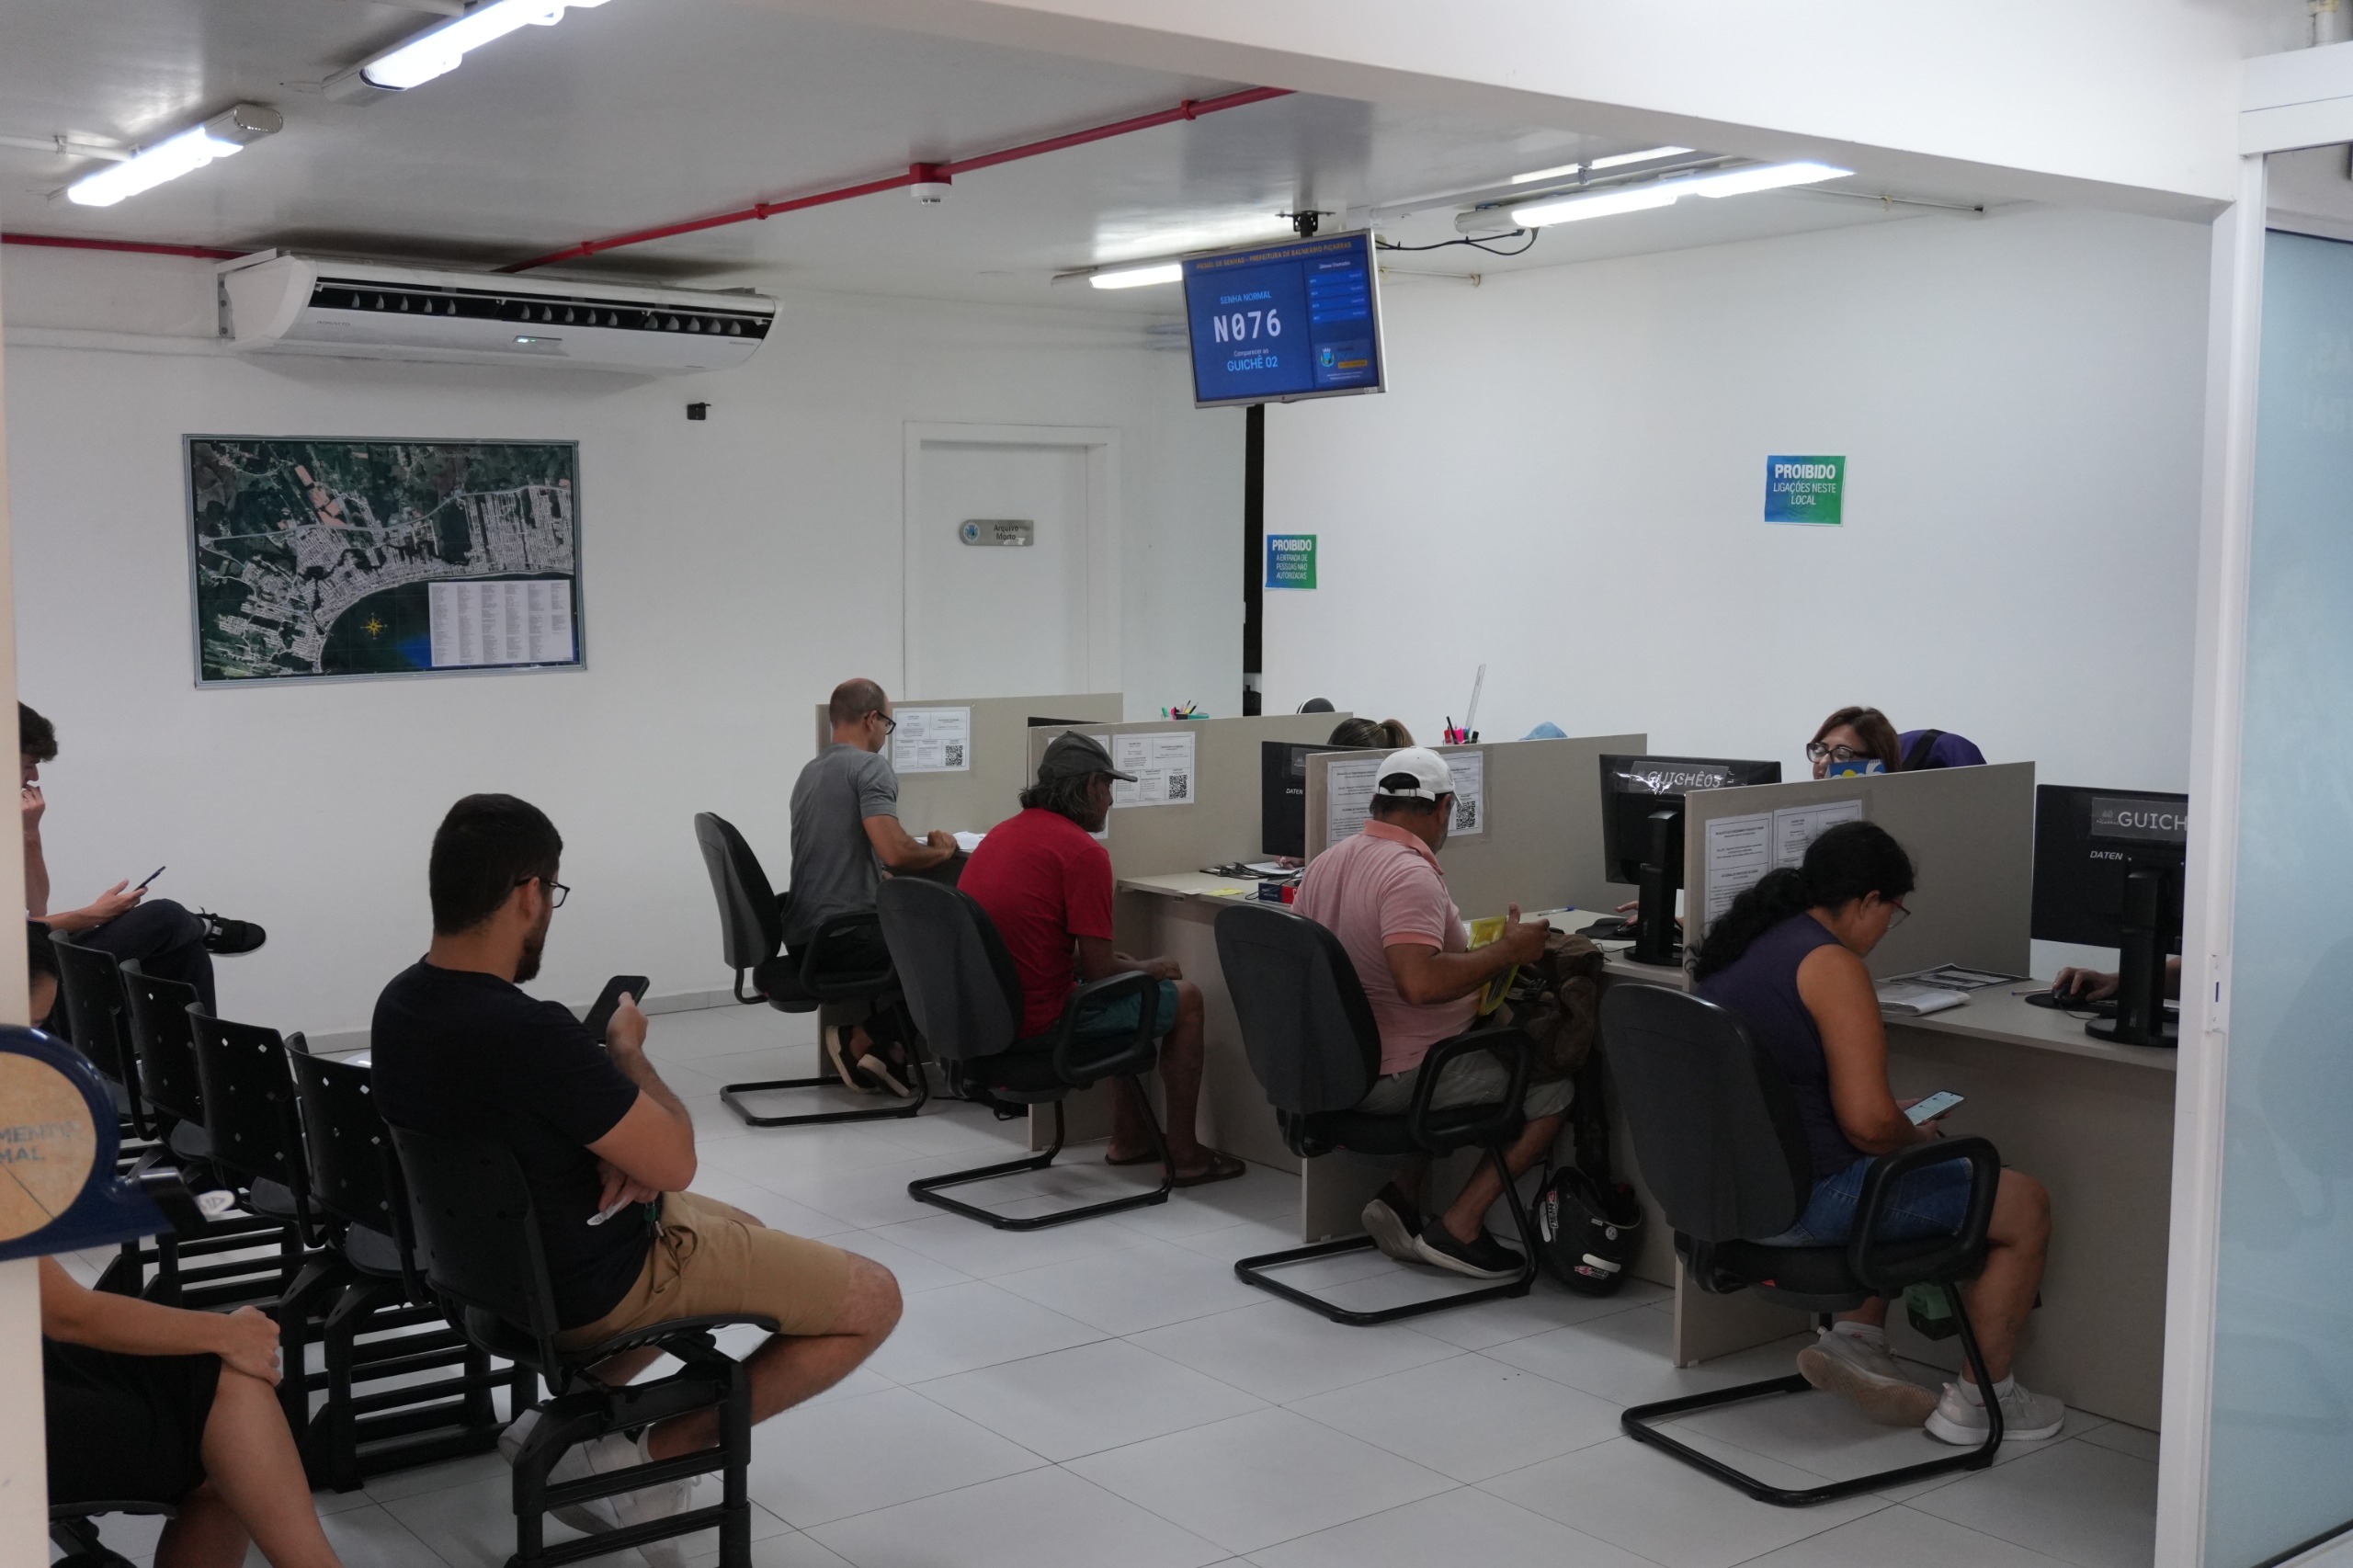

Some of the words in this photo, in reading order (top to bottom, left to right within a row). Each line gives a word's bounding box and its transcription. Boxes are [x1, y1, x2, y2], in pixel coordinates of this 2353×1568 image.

[1223, 257, 1245, 267] SENHAS
[1249, 251, 1282, 262] PREFEITURA
[1282, 249, 1290, 257] DE
[1220, 295, 1243, 305] SENHA
[1243, 290, 1272, 301] NORMAL
[1213, 308, 1281, 343] N076
[1233, 348, 1262, 357] Comparecer
[1227, 354, 1264, 372] GUICHÊ
[1265, 355, 1279, 369] 02
[1775, 463, 1836, 479] PROIBIDO
[1773, 481, 1811, 494] LIGAÇÕES
[1812, 483, 1836, 494] NESTE
[1790, 494, 1817, 506] LOCAL
[994, 524, 1019, 533] Arquivo
[1272, 539, 1313, 551] PROIBIDO
[1279, 553, 1301, 562] ENTRADA
[1301, 553, 1308, 562] DE
[1276, 562, 1297, 571] PESSOAS
[1276, 572, 1307, 580] AUTORIZADAS
[2118, 811, 2188, 831] GUICH
[2089, 850, 2123, 860] DATEN
